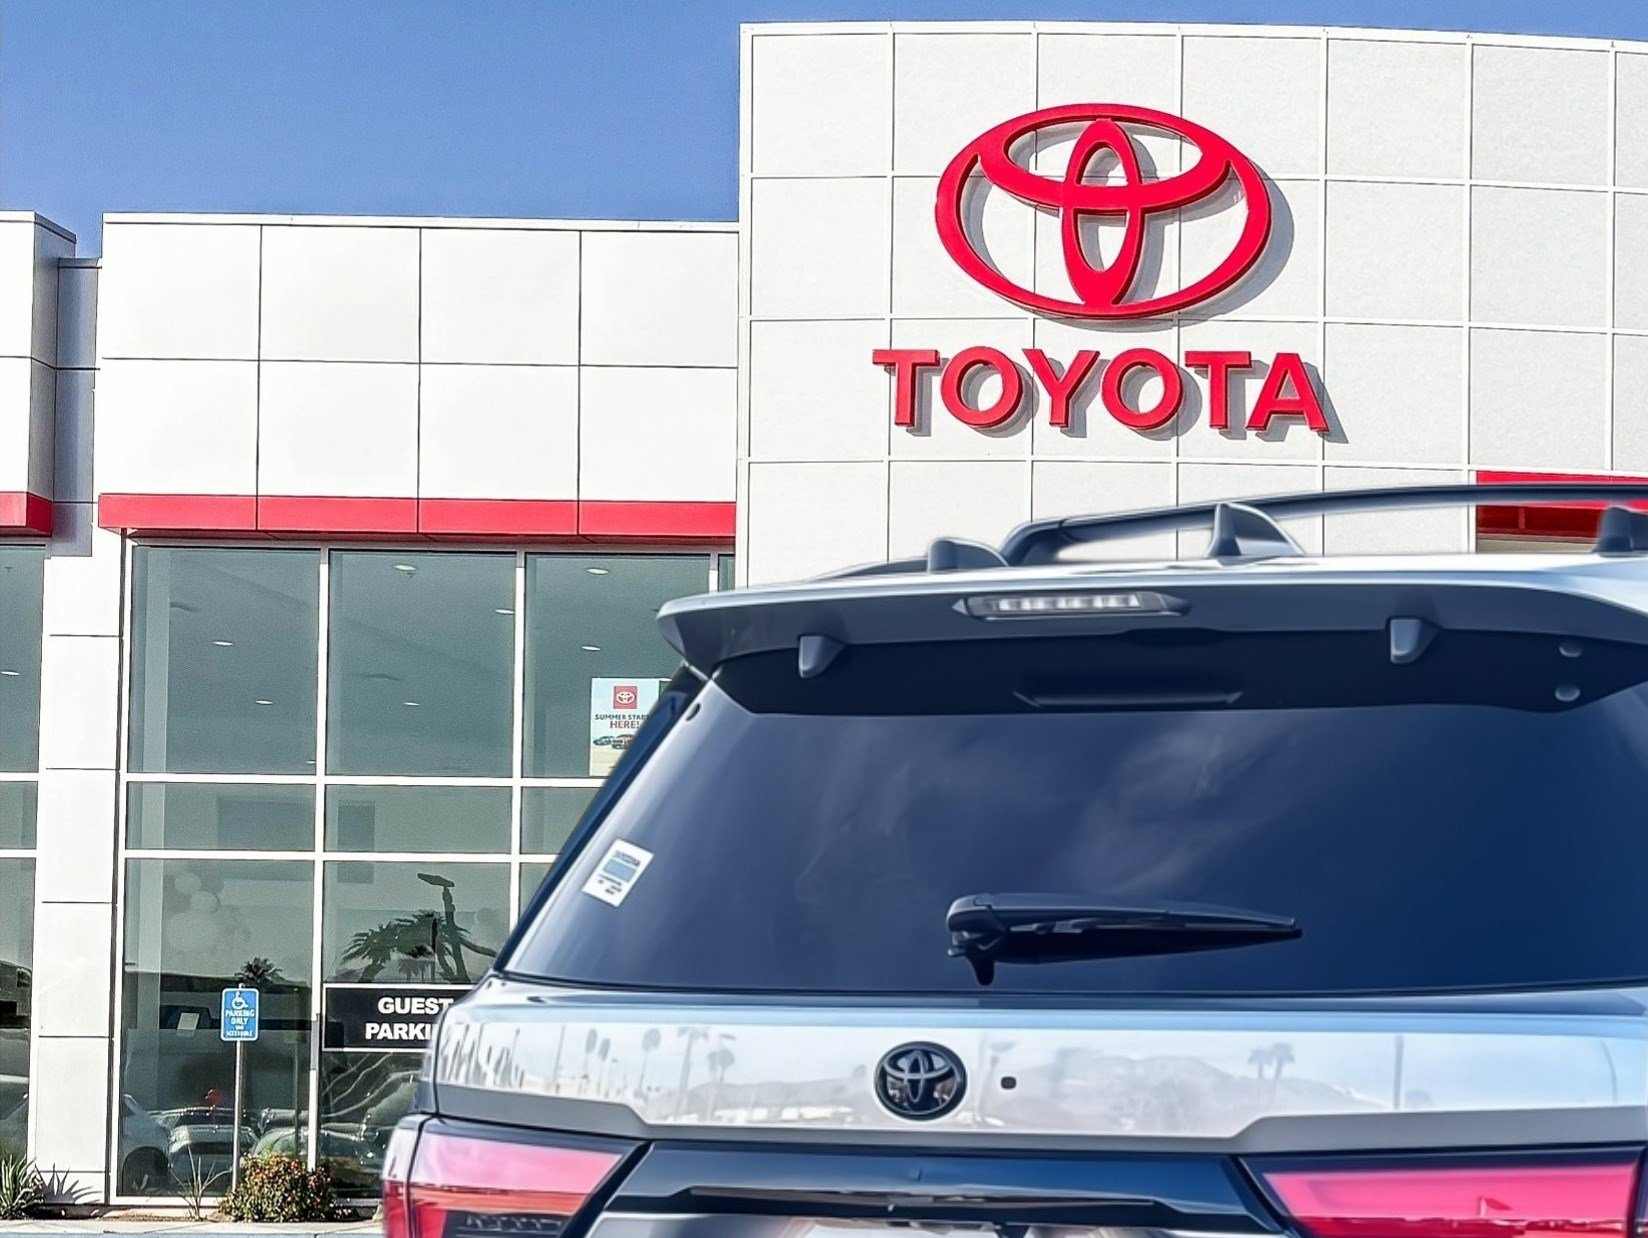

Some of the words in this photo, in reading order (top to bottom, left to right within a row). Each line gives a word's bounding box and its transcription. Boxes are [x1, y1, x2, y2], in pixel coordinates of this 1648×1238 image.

[872, 345, 1329, 434] TOYOTA
[610, 720, 640, 729] HERE!
[225, 1009, 255, 1017] PARKING
[377, 996, 455, 1015] GUEST
[365, 1022, 432, 1040] PARKI
